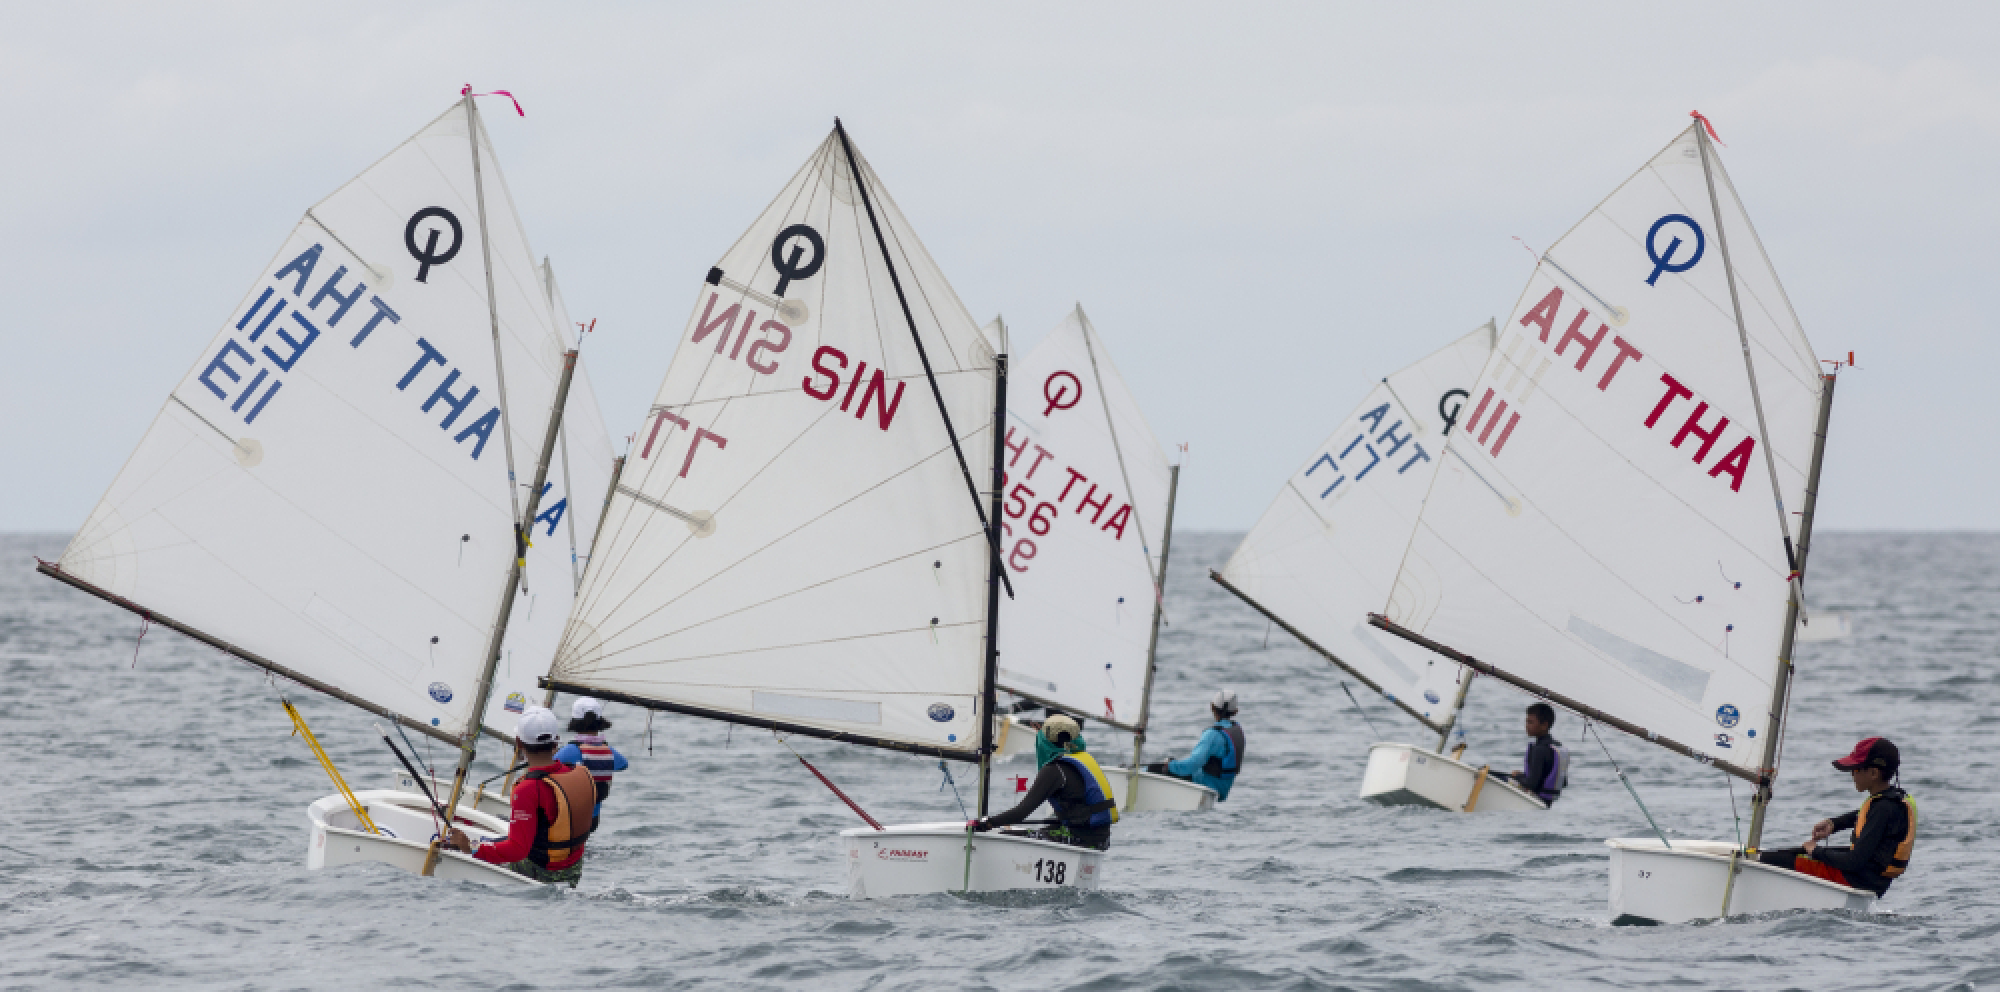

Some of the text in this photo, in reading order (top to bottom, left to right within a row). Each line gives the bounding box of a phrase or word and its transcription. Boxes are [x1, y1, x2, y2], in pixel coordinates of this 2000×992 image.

[395, 336, 502, 462] THA
[801, 344, 907, 432] SIN
[1643, 371, 1756, 493] THA
[1002, 471, 1059, 537] 56
[1057, 465, 1133, 541] THA
[1034, 857, 1067, 885] 138
